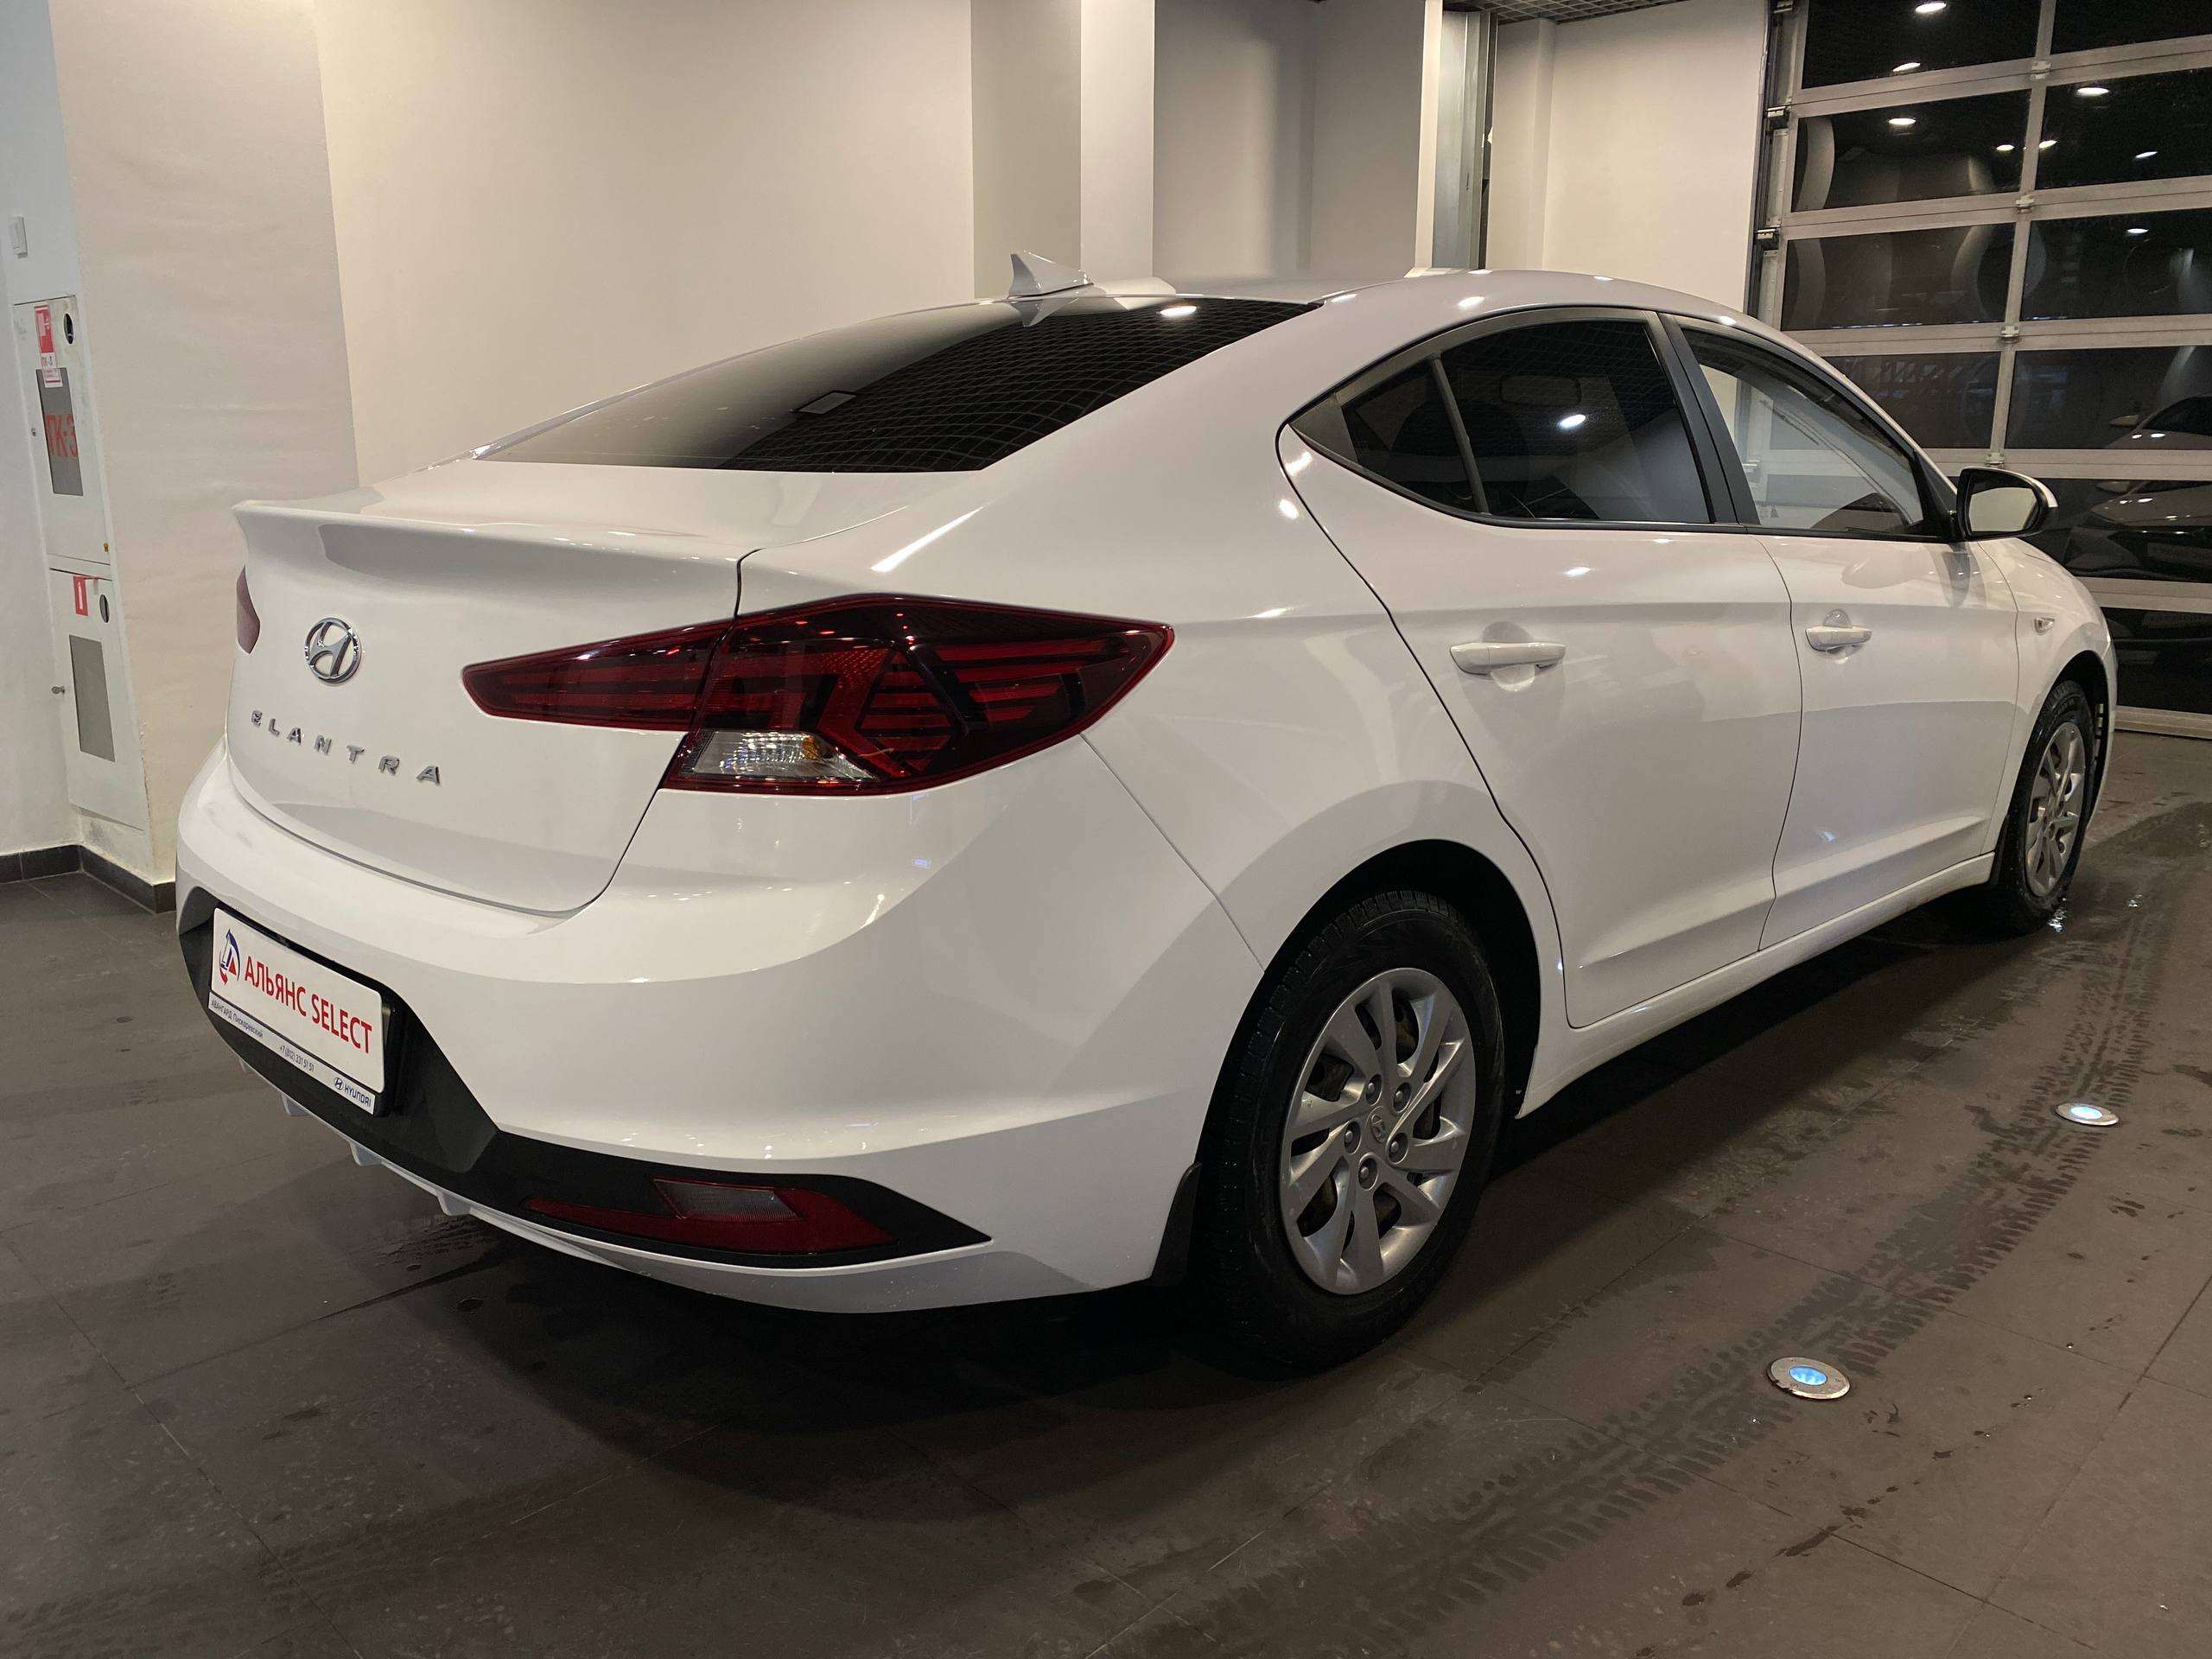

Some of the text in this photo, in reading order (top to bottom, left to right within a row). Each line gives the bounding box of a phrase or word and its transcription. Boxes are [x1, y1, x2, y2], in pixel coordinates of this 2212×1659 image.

[251, 709, 442, 786] ELANTRA
[245, 956, 372, 1054] АЛЬЯНС SELECT
[345, 1084, 372, 1107] HYUNDAI
